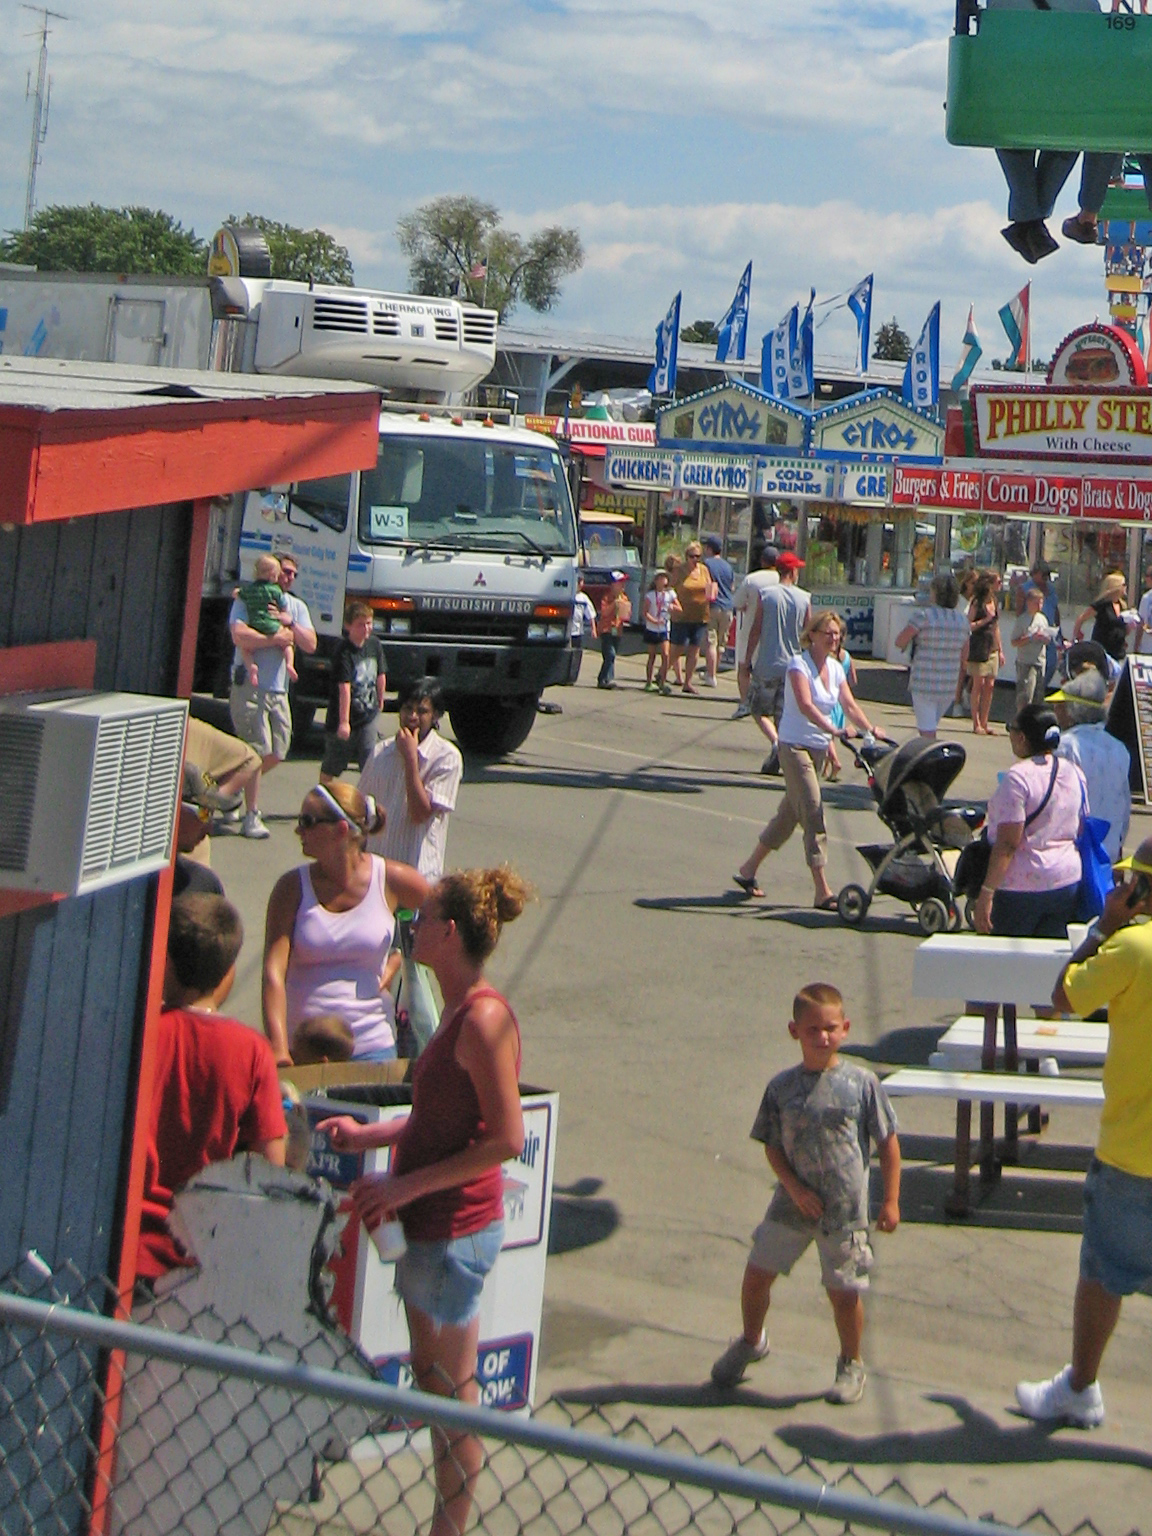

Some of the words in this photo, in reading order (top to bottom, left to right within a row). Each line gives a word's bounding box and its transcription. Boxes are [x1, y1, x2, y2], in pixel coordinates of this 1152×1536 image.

[1105, 16, 1136, 30] 169
[377, 301, 424, 315] THERMO
[426, 305, 452, 317] KING
[699, 399, 762, 439] GYROS
[987, 396, 1090, 441] PHILLY
[842, 417, 917, 451] GYROS
[1046, 437, 1078, 451] With
[1083, 438, 1132, 452] Cheese
[611, 458, 660, 481] CHICKEN
[683, 465, 712, 487] GREEK
[714, 468, 748, 490] GYROS
[775, 469, 814, 482] COLD
[767, 480, 822, 494] DRINKS
[895, 468, 937, 505] Burgers
[940, 472, 950, 501] &
[952, 472, 980, 500] Fries
[986, 476, 1029, 503] Corn
[1033, 477, 1078, 516] Dogs
[1084, 480, 1112, 508] Brats
[1114, 484, 1125, 510] &
[375, 513, 405, 528] W-3
[421, 596, 496, 612] MITSUBISHI
[500, 600, 531, 613] FUSO
[483, 1348, 511, 1377] OF
